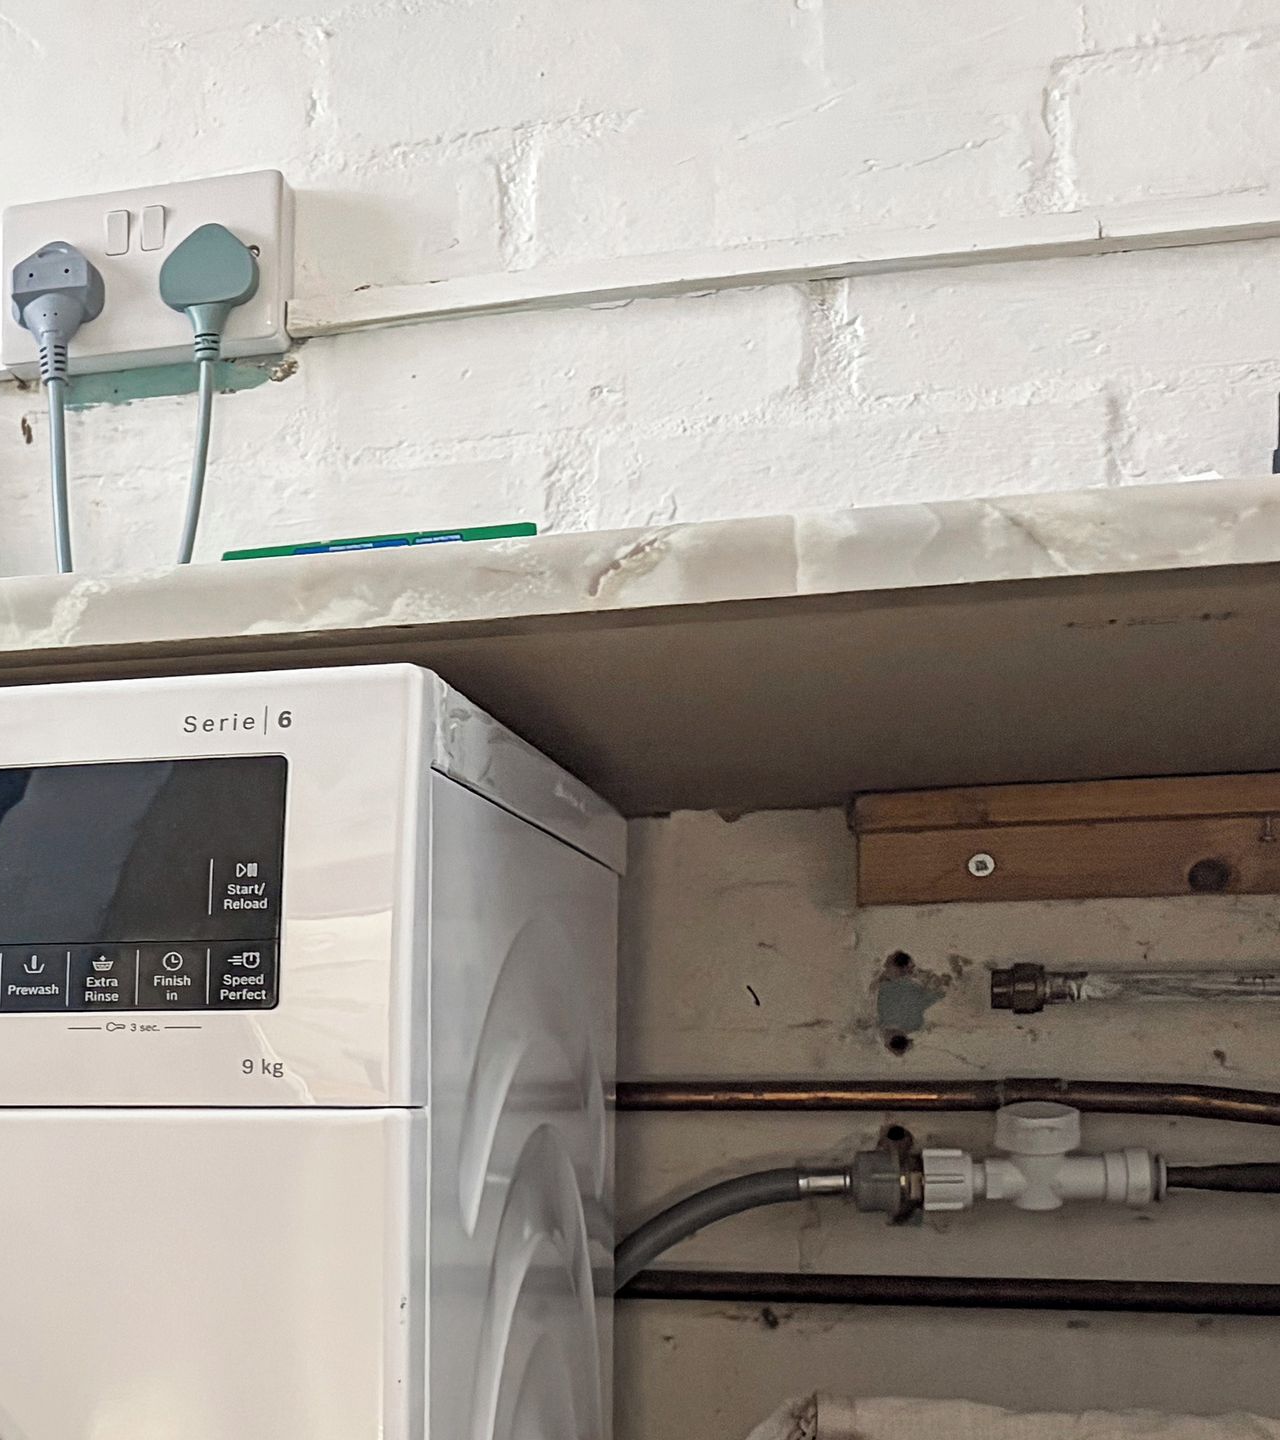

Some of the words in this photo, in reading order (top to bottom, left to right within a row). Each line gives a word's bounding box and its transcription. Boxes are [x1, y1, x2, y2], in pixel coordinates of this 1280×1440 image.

[182, 712, 256, 734] Serie
[277, 709, 293, 730] 6
[227, 881, 266, 898] Start/
[223, 896, 268, 912] Reload
[86, 974, 119, 990] Extra
[153, 972, 192, 988] Finish
[222, 972, 264, 990] Speed
[7, 982, 60, 998] Prewash
[84, 989, 120, 1004] Rinse
[166, 988, 178, 1002] in
[219, 986, 267, 1002] Perfect
[130, 1022, 138, 1032] 3
[140, 1022, 160, 1032] sec.
[242, 1058, 255, 1075] 9
[260, 1058, 284, 1078] kg
